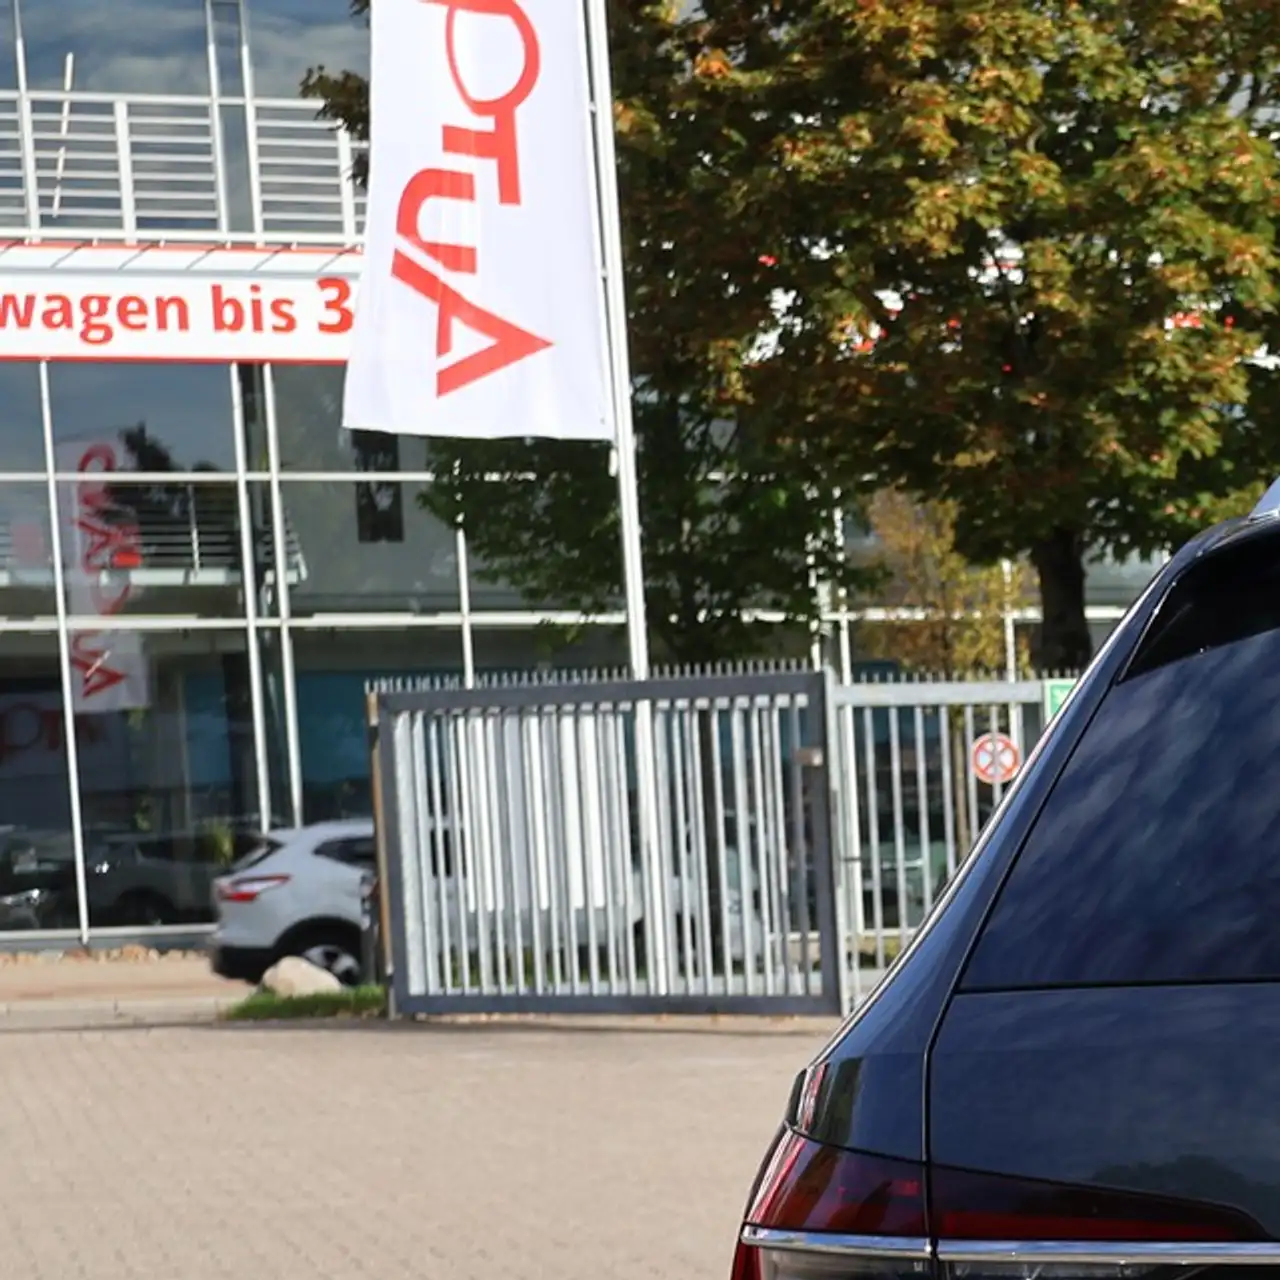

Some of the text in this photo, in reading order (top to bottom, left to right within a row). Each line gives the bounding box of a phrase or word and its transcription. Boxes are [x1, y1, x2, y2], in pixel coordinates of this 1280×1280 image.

[0, 276, 355, 345] wagen bis 3
